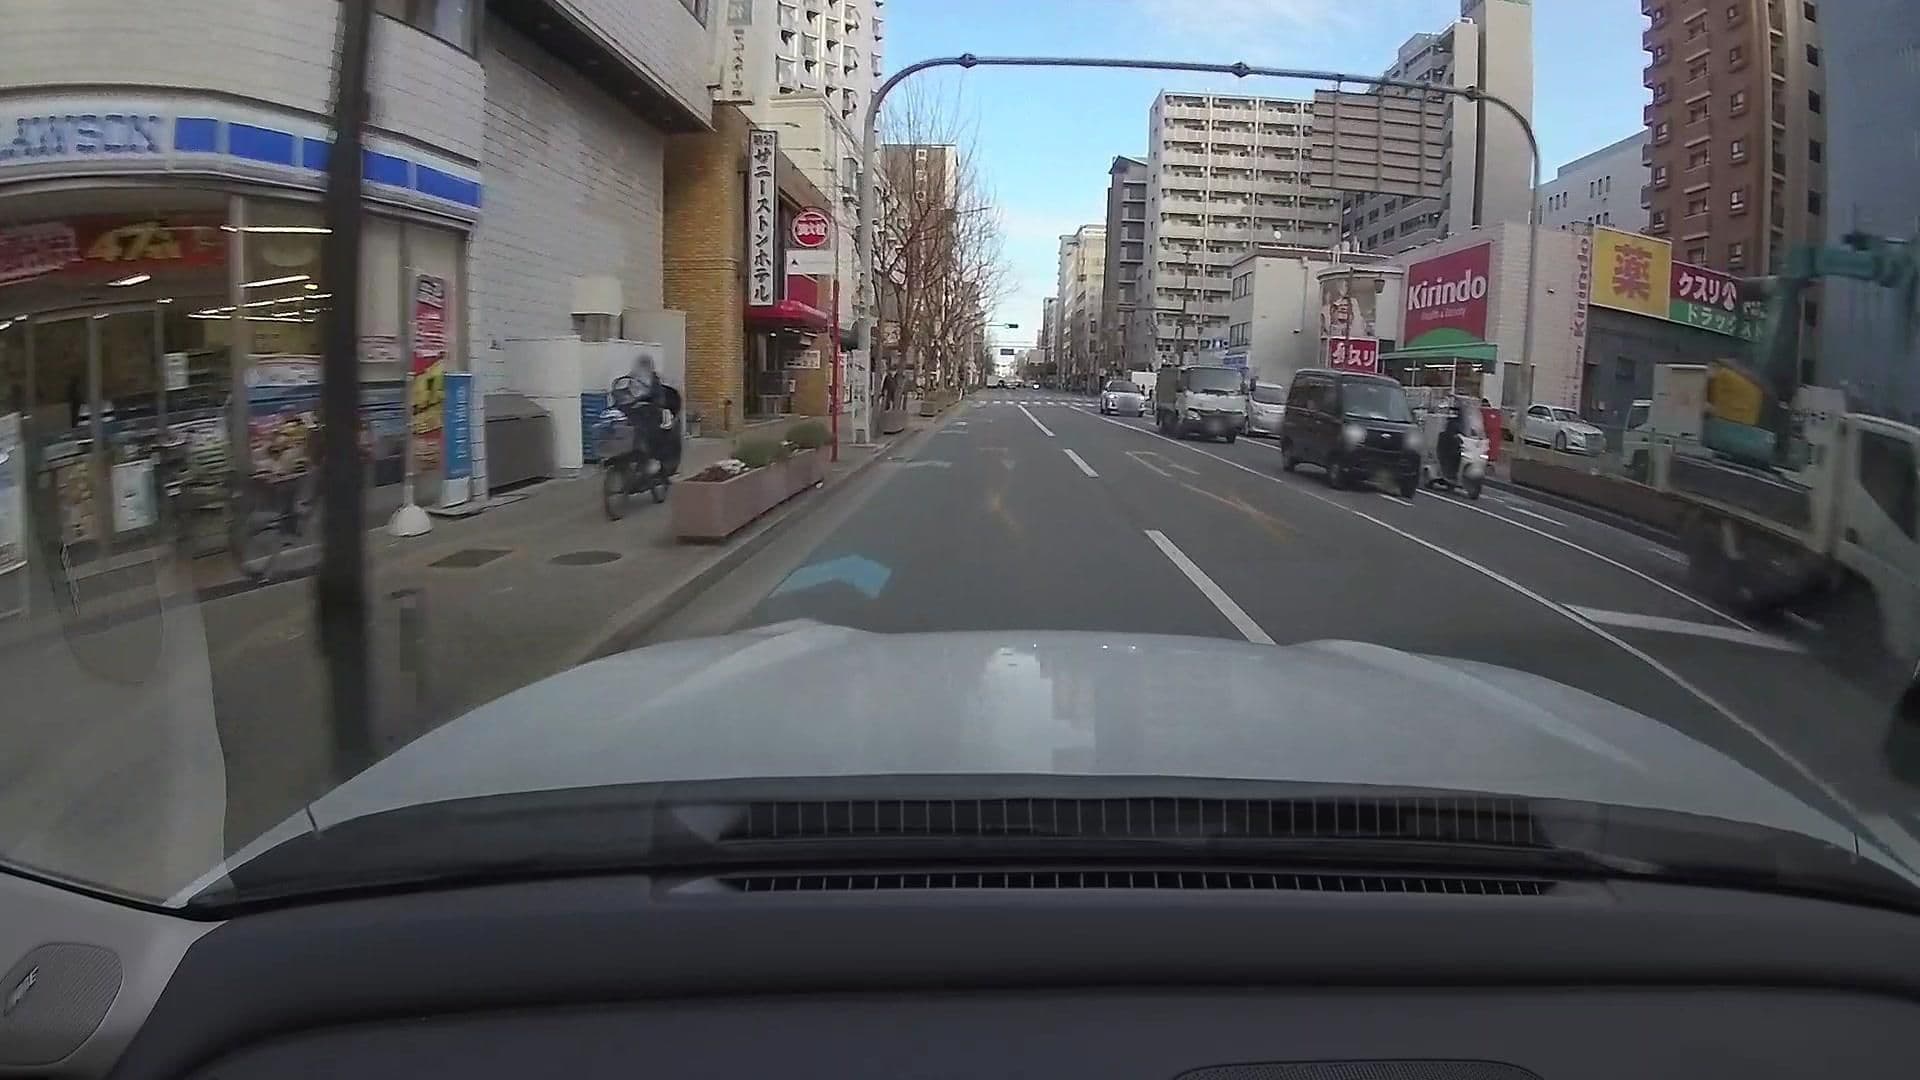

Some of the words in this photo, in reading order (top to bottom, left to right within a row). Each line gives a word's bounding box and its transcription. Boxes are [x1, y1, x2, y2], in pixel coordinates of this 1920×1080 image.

[0, 113, 160, 157] AWSON
[754, 147, 772, 302] サニーストンホテル
[1407, 268, 1488, 311] Kirindo
[1611, 243, 1652, 300] 薬
